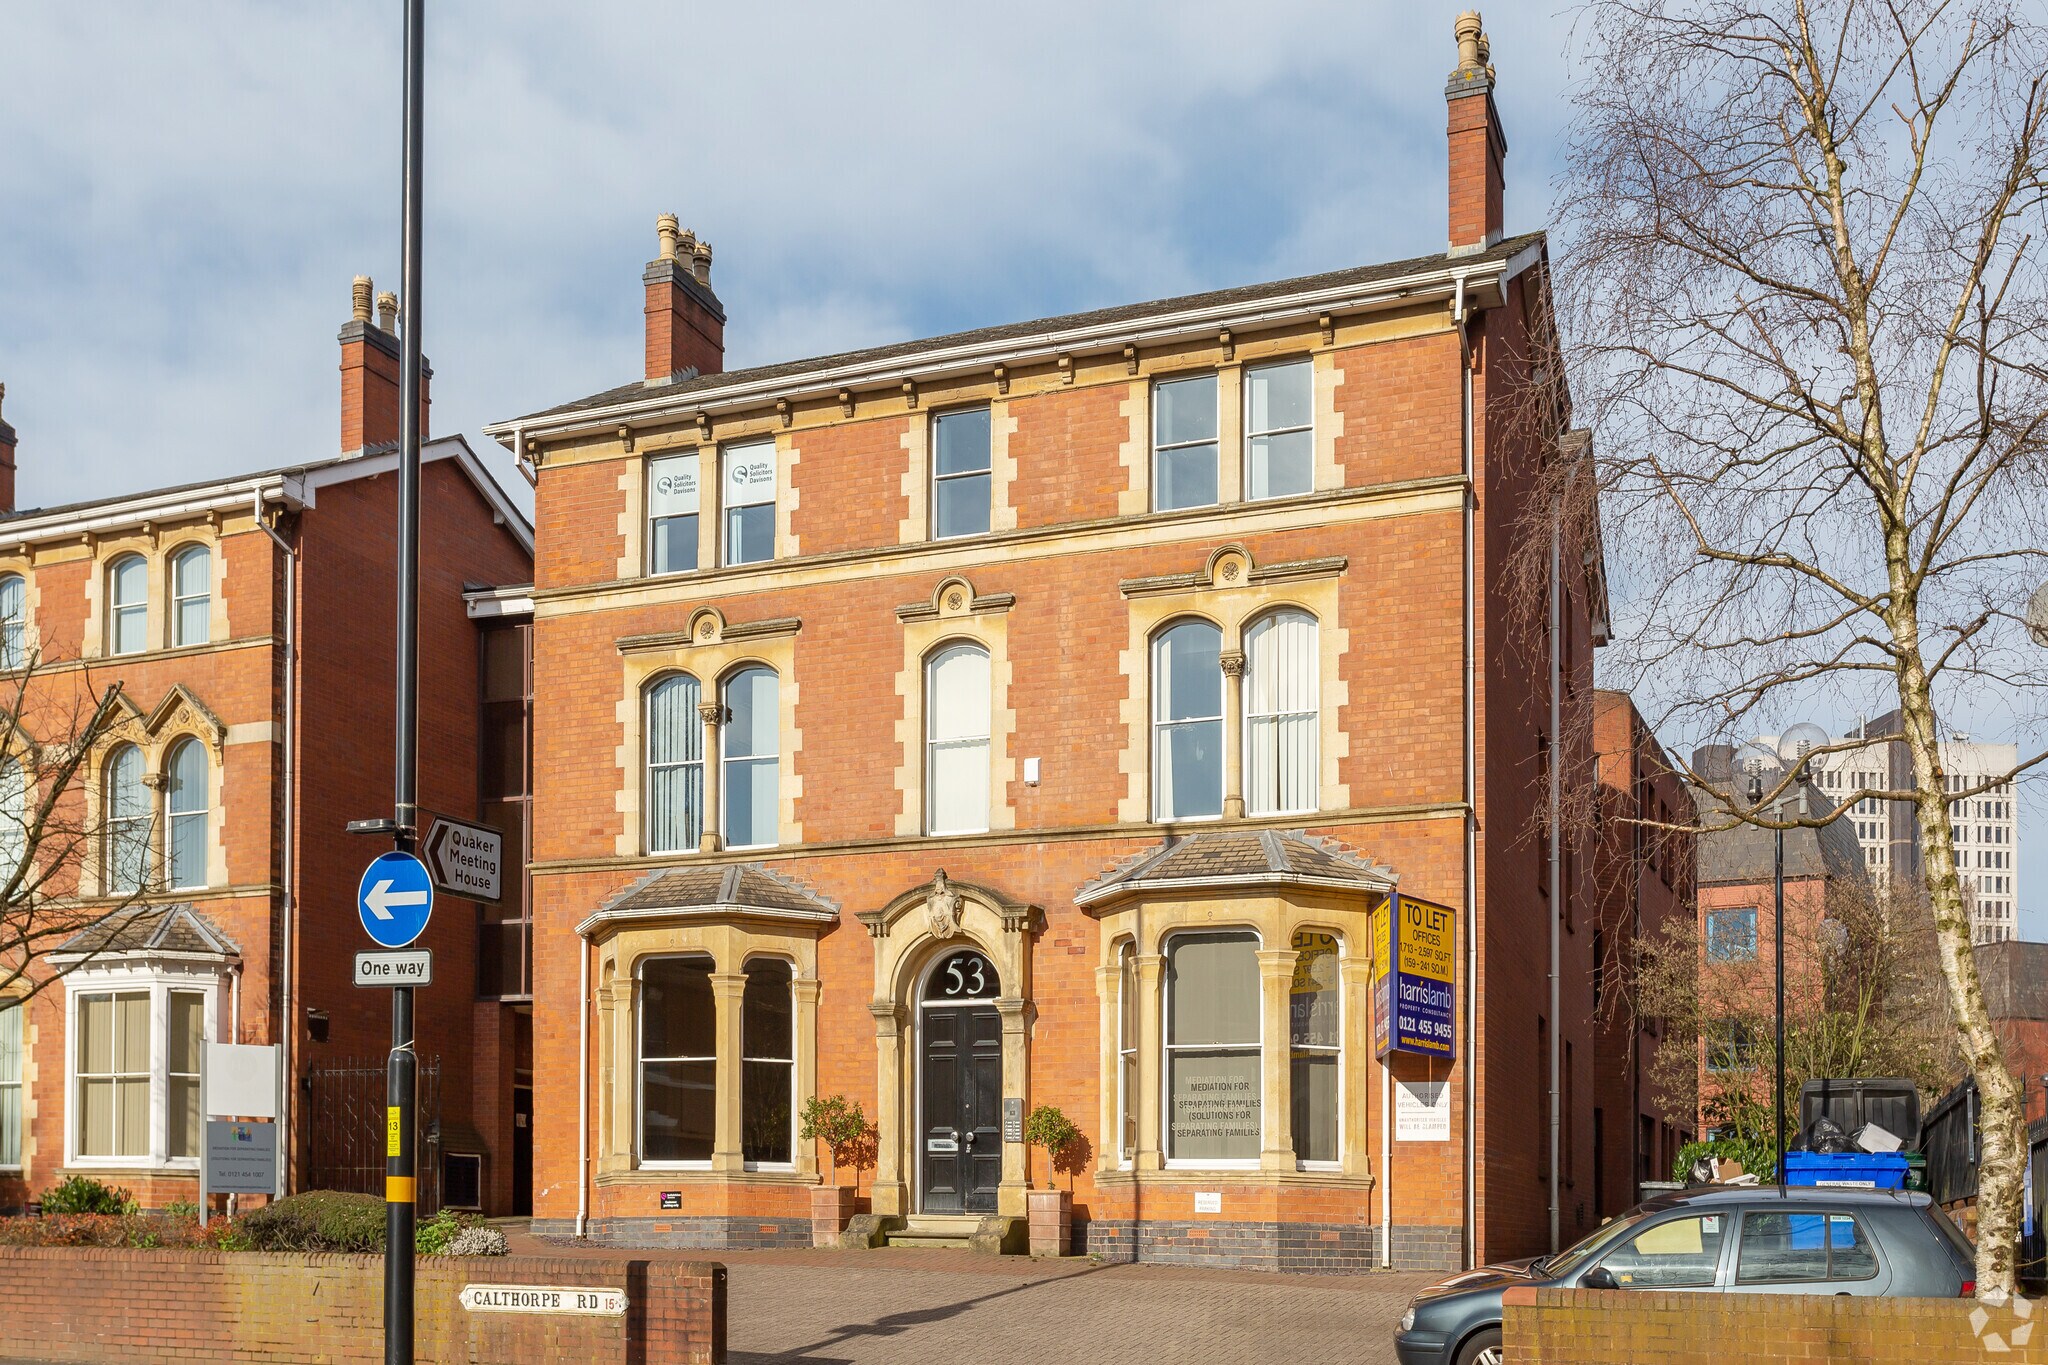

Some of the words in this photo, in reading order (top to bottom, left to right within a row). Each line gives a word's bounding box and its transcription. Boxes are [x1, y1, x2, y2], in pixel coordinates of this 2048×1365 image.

[749, 462, 768, 470] Quality
[749, 468, 773, 477] Solicitors
[673, 473, 692, 482] Quality
[673, 480, 697, 489] Solicitors
[749, 476, 773, 484] Davisons
[673, 487, 696, 495] Davisons
[452, 830, 494, 854] Quaker
[450, 849, 496, 875] Meeting
[455, 869, 491, 890] House
[1405, 903, 1422, 927] TO
[1426, 908, 1448, 933] LET
[1412, 929, 1441, 948] OFFICES
[1418, 946, 1434, 959] 2,597
[361, 960, 390, 976] One
[396, 962, 425, 977] way
[1404, 955, 1416, 969] (159
[1420, 960, 1431, 972] 241
[945, 957, 985, 995] 53
[1399, 976, 1452, 1009] harrislamb
[1399, 1002, 1421, 1013] PROPERTY
[1421, 1007, 1452, 1019] CONSULTANCY
[1398, 1015, 1416, 1032] 0121
[1418, 1019, 1432, 1035] 455
[1434, 1022, 1452, 1039] 9455
[1401, 1036, 1450, 1052] www.harrislamb.com
[1190, 1082, 1232, 1091] MEDIATION
[1233, 1082, 1249, 1091] FOR
[1188, 1111, 1234, 1121] (SOLUTIONS
[1235, 1110, 1251, 1119] FOR
[388, 1121, 399, 1131] 13
[1177, 1128, 1223, 1138] SEPARATING
[473, 1291, 561, 1308] CALTHORPE
[577, 1294, 598, 1309] RD
